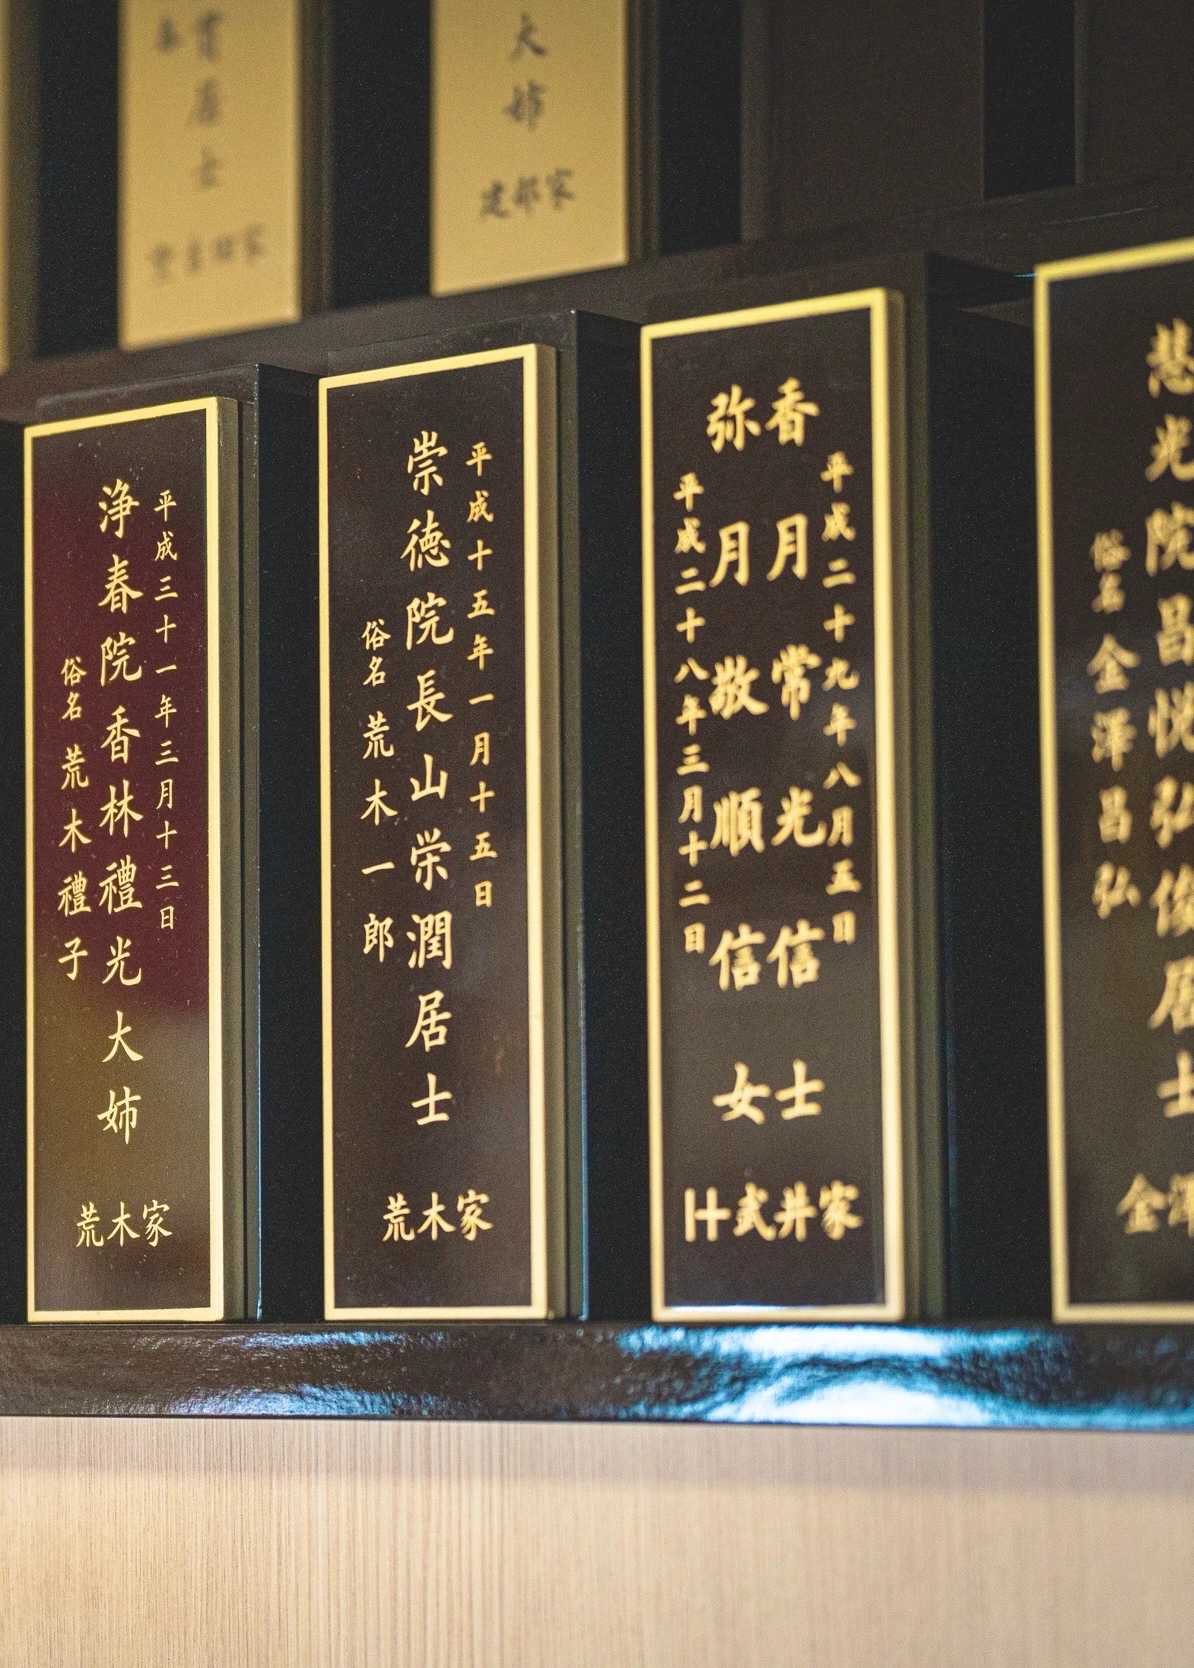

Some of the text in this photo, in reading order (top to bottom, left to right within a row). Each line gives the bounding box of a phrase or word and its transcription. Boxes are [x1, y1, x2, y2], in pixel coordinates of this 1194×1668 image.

[153, 488, 181, 931] 平成三十一年三月十三日
[400, 430, 455, 1126] 崇徳院長山栄潤居士
[465, 440, 498, 909] 平成十五年一月十五日
[672, 471, 710, 955] 平成二十八年三月十二日
[820, 450, 862, 945] 平成二十九年八月五日
[75, 1199, 173, 1248] 荒木家
[382, 1188, 494, 1242] 荒木家
